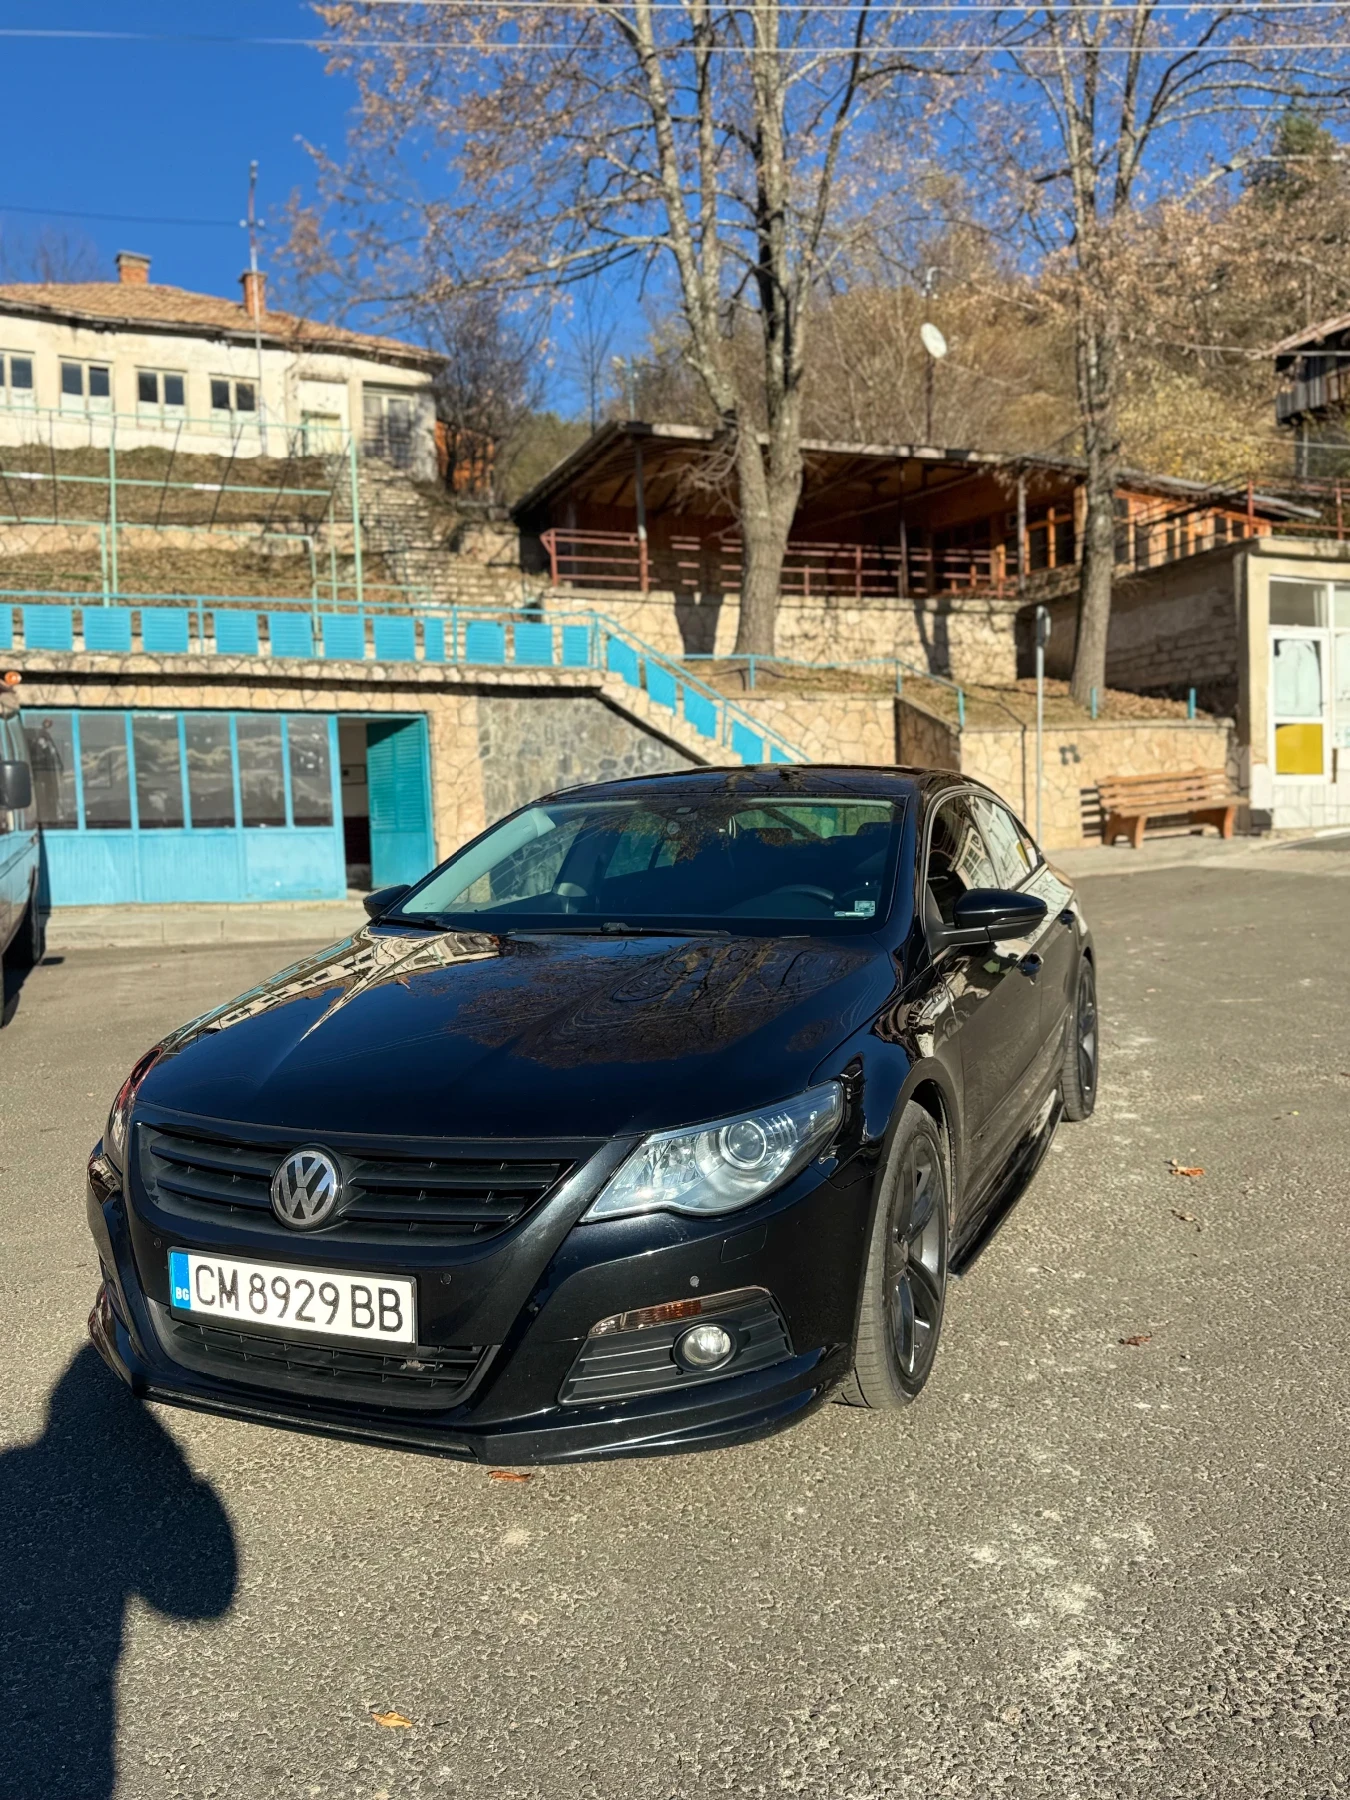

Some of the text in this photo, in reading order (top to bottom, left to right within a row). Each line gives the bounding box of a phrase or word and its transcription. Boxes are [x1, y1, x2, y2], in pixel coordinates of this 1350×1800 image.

[274, 1151, 336, 1224] VW
[175, 1287, 190, 1301] BG
[195, 1264, 403, 1332] CM 8929 BB
